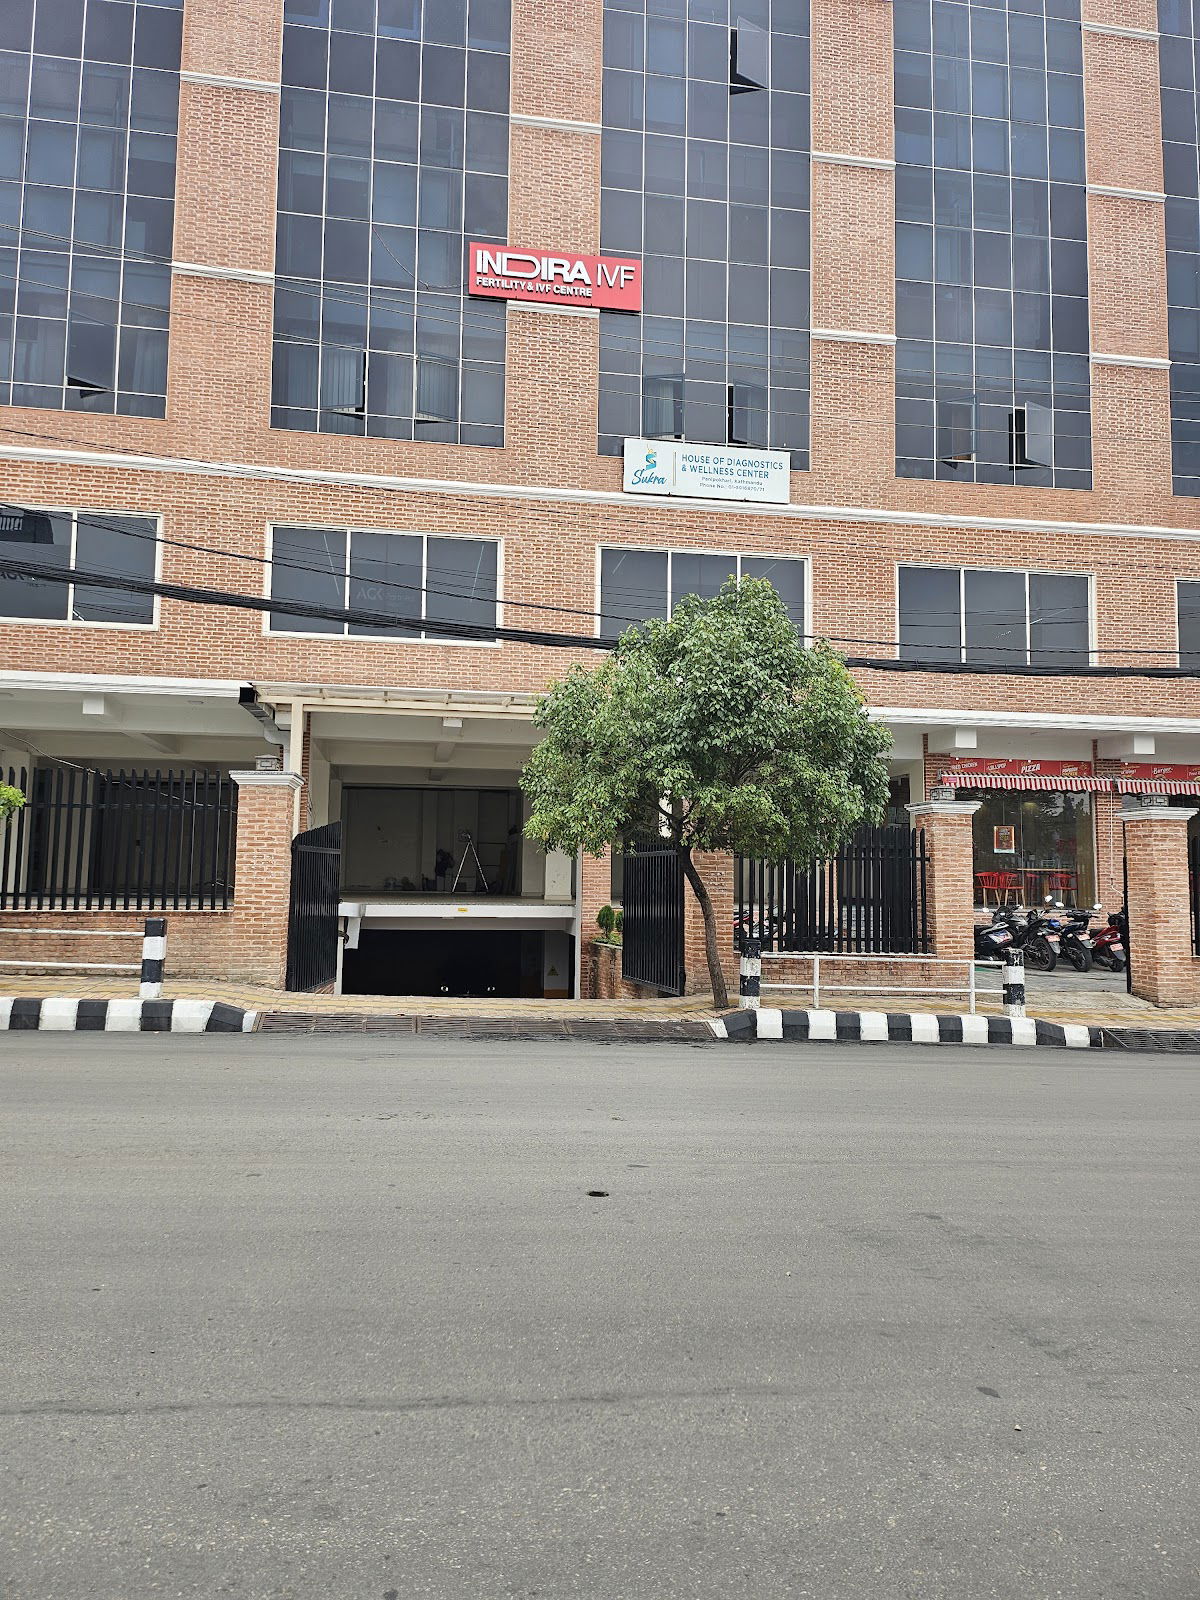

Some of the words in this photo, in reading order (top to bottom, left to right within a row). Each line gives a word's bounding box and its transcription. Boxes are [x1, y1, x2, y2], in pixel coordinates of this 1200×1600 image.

[476, 249, 592, 286] INDIRA
[597, 263, 635, 289] IVF
[476, 276, 525, 291] FERTILITY
[526, 281, 534, 291] &
[535, 282, 551, 293] IVF
[553, 285, 593, 298] CENTRE
[681, 454, 711, 464] HOUSE
[712, 456, 725, 465] OF
[727, 457, 784, 470] DIAGNOSTICS
[631, 468, 668, 485] Sukra
[681, 464, 687, 472] &
[689, 465, 734, 476] WELLNESS
[736, 469, 770, 479] CENTER
[1021, 763, 1040, 773] PIZZA
